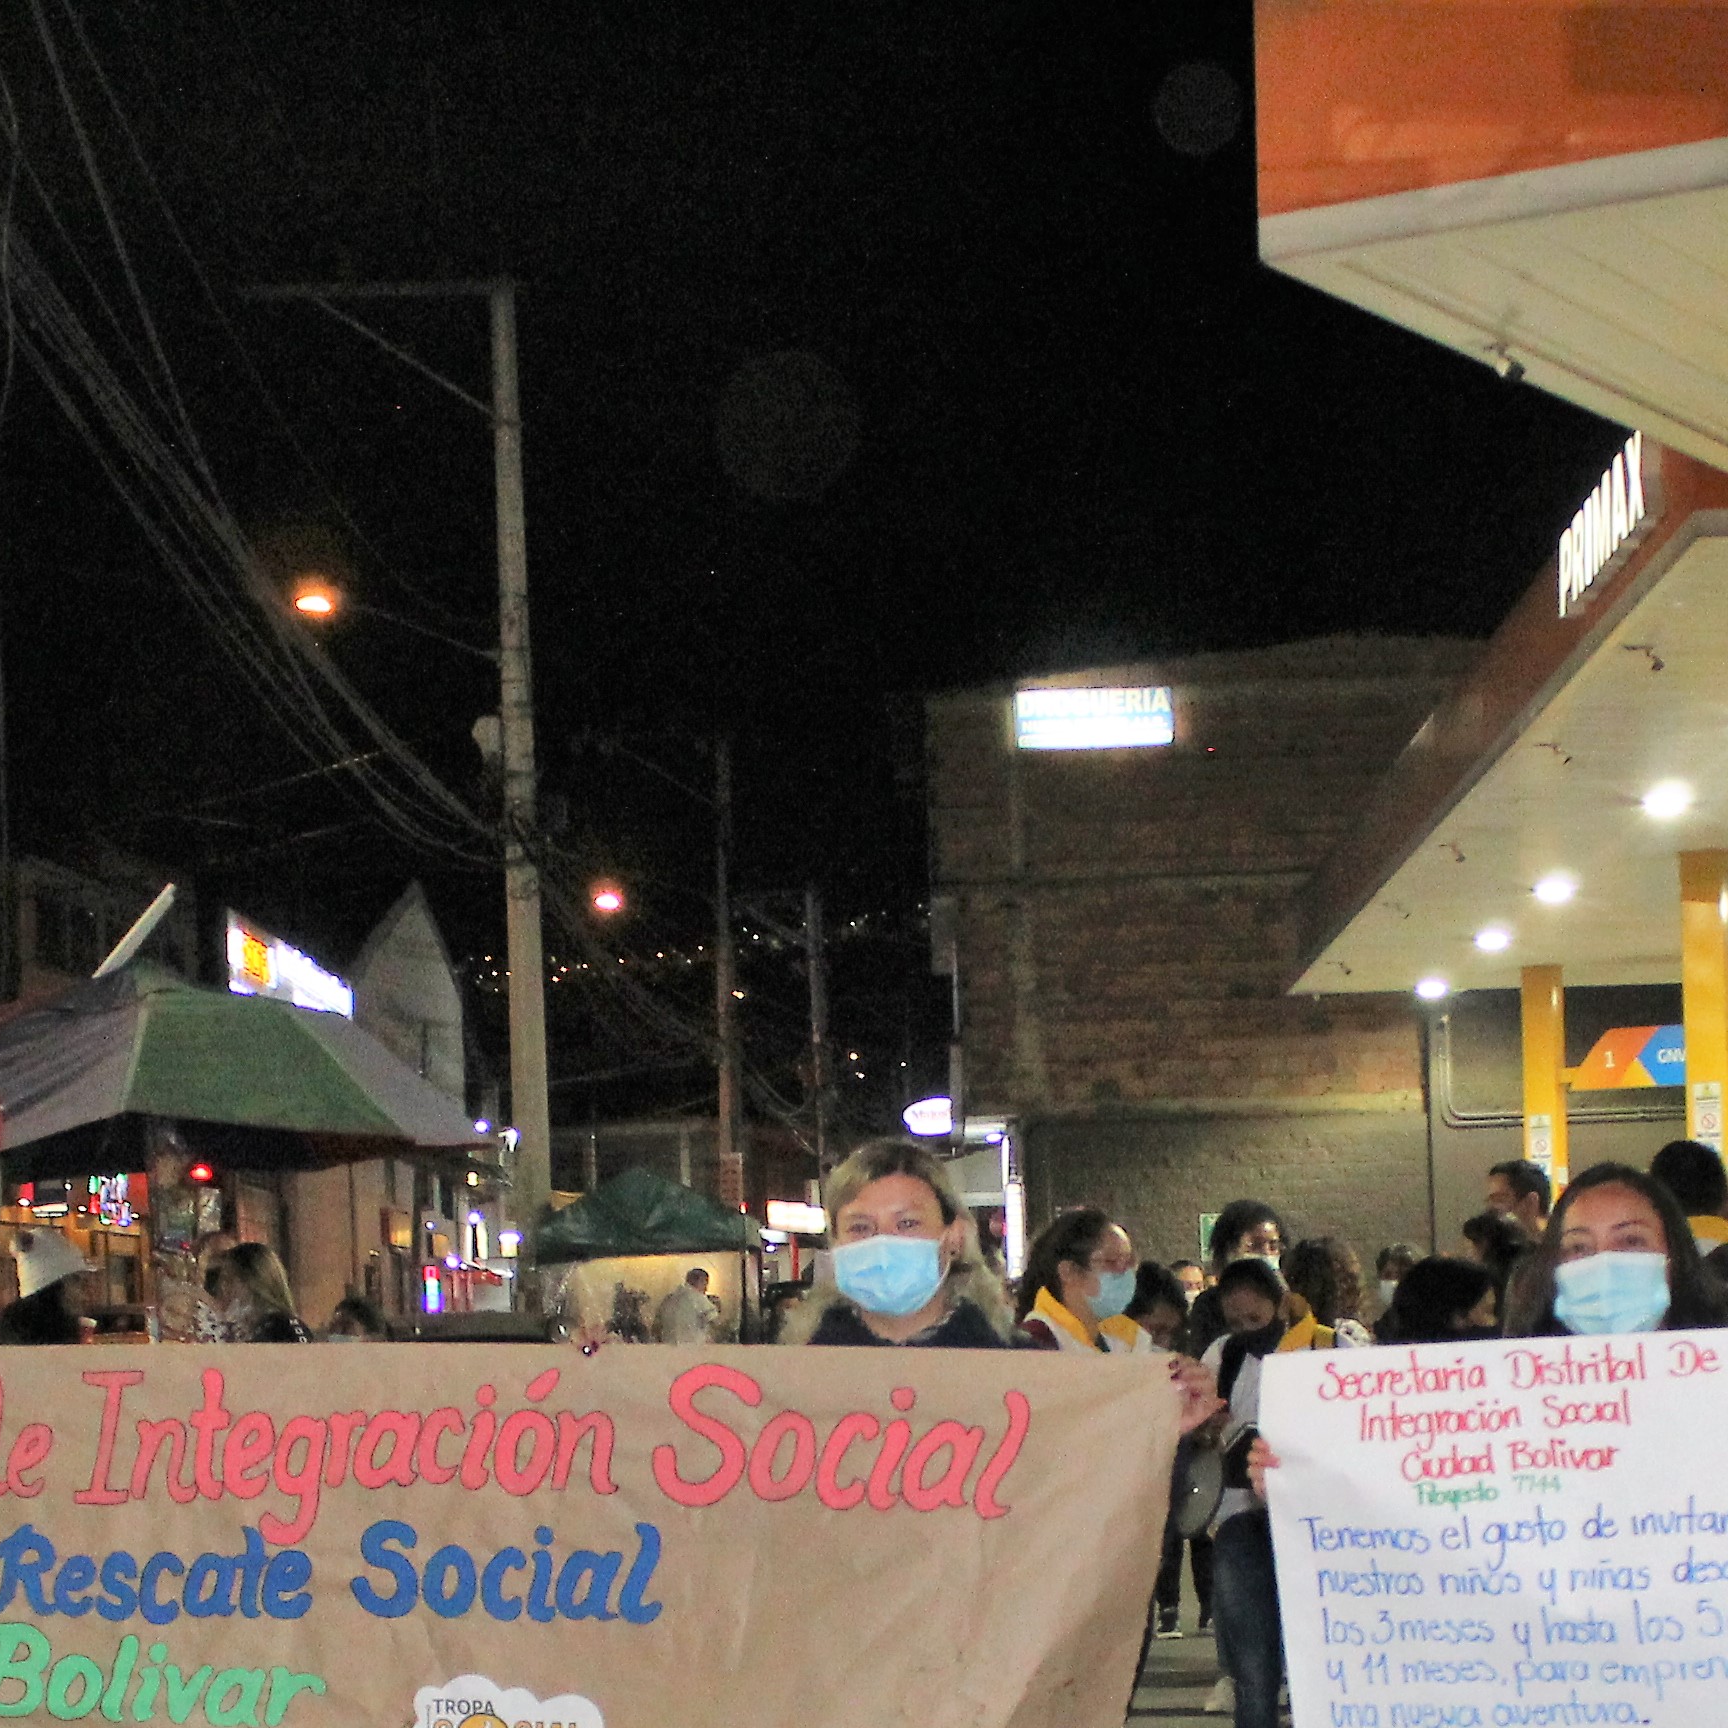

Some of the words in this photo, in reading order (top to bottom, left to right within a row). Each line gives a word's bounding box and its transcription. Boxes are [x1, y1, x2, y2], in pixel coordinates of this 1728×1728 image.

[1559, 430, 1645, 618] PRIMAX
[1604, 1052, 1614, 1068] 1
[1318, 1354, 1487, 1401] Secretaria
[1504, 1344, 1646, 1391] Distrital
[1668, 1339, 1720, 1379] De
[1359, 1399, 1521, 1451] Integración
[1542, 1390, 1631, 1427] Social
[74, 1367, 618, 1545] Integración
[652, 1363, 1030, 1520] Social
[1402, 1439, 1496, 1483] Ciudad
[1512, 1474, 1561, 1493] 7744
[1299, 1516, 1431, 1553] Tenemos
[1443, 1514, 1473, 1551] el
[1482, 1505, 1566, 1572] gusto
[1582, 1503, 1618, 1541] de
[351, 1520, 663, 1623] Social
[1317, 1566, 1423, 1598] nuestros
[1439, 1566, 1520, 1597] niños
[1537, 1571, 1557, 1605] y
[1570, 1559, 1650, 1594] niñas
[1322, 1608, 1365, 1647] los
[1511, 1617, 1532, 1661] y
[1544, 1609, 1618, 1646] hasta
[1634, 1600, 1684, 1644] los
[1326, 1656, 1346, 1692] y
[1359, 1655, 1389, 1686] 11
[1515, 1653, 1590, 1697] para
[433, 1699, 495, 1715] TROPA
